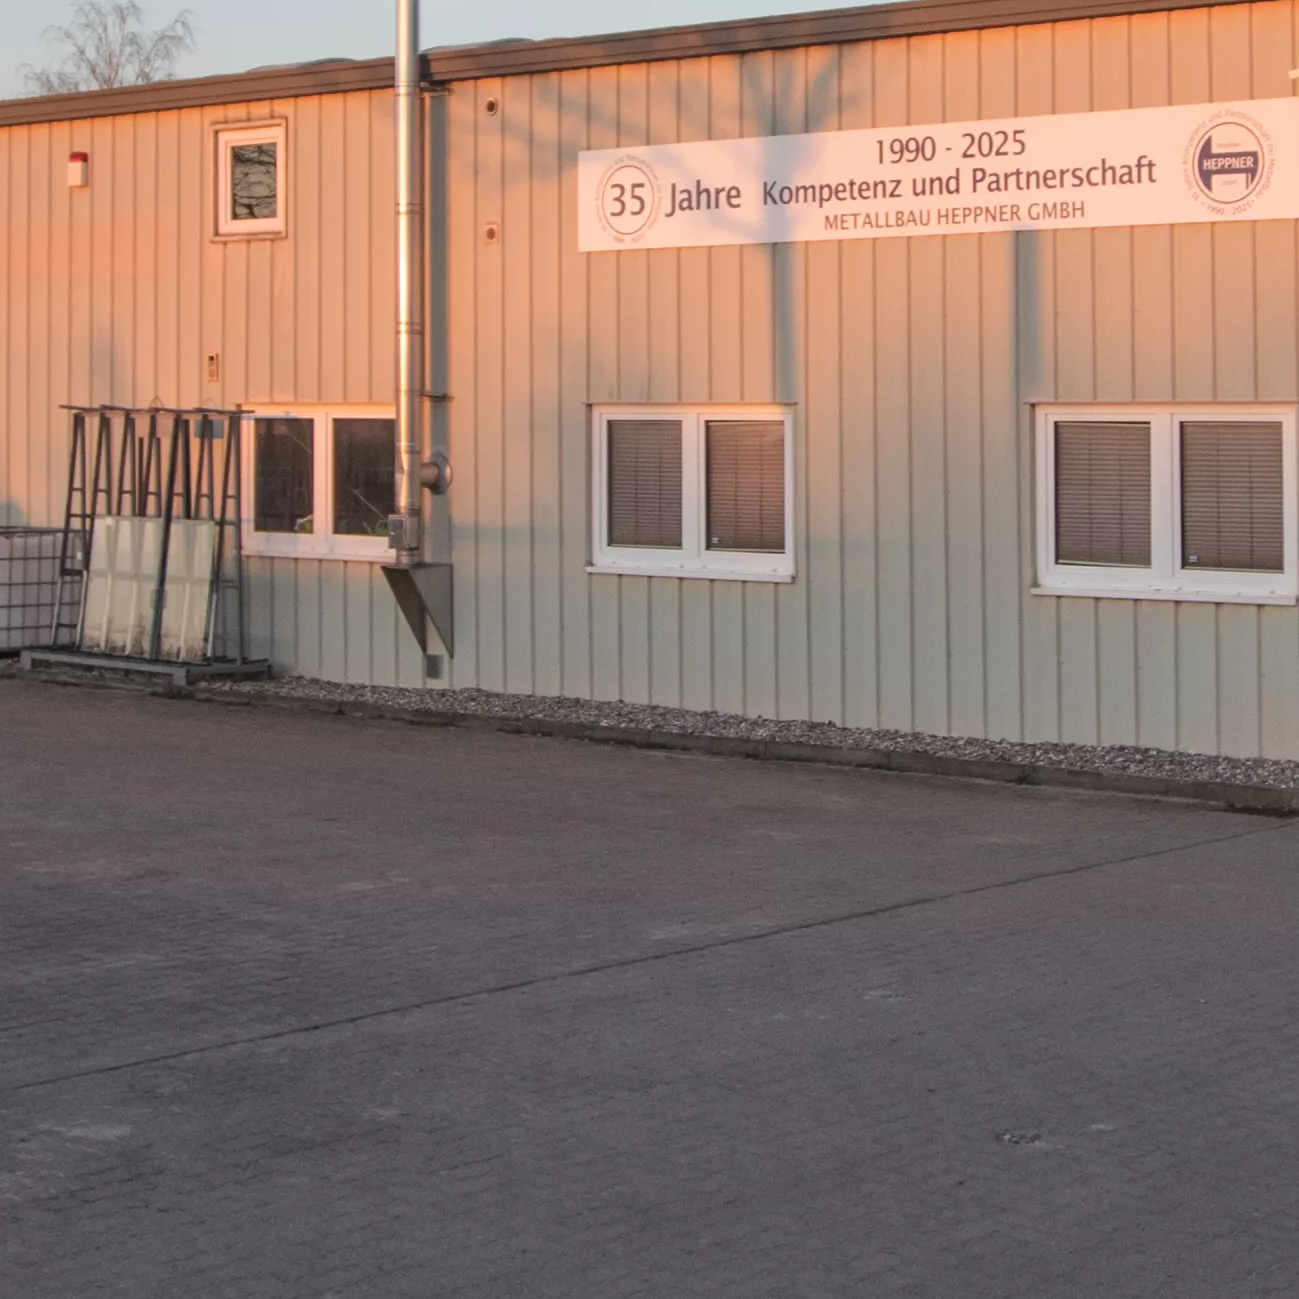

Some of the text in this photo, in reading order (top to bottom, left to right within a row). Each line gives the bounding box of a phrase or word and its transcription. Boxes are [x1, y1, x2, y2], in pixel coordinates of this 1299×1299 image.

[876, 136, 936, 165] 1990
[961, 129, 1026, 159] 2025
[1203, 156, 1254, 170] HEPPNER
[610, 182, 646, 217] 35
[665, 179, 741, 217] Jahre
[763, 179, 902, 208] Kompetenz
[913, 168, 960, 196] und
[972, 155, 1156, 193] Partnerschaft
[824, 201, 1085, 230] METALLBAU HEPPNER GMBH
